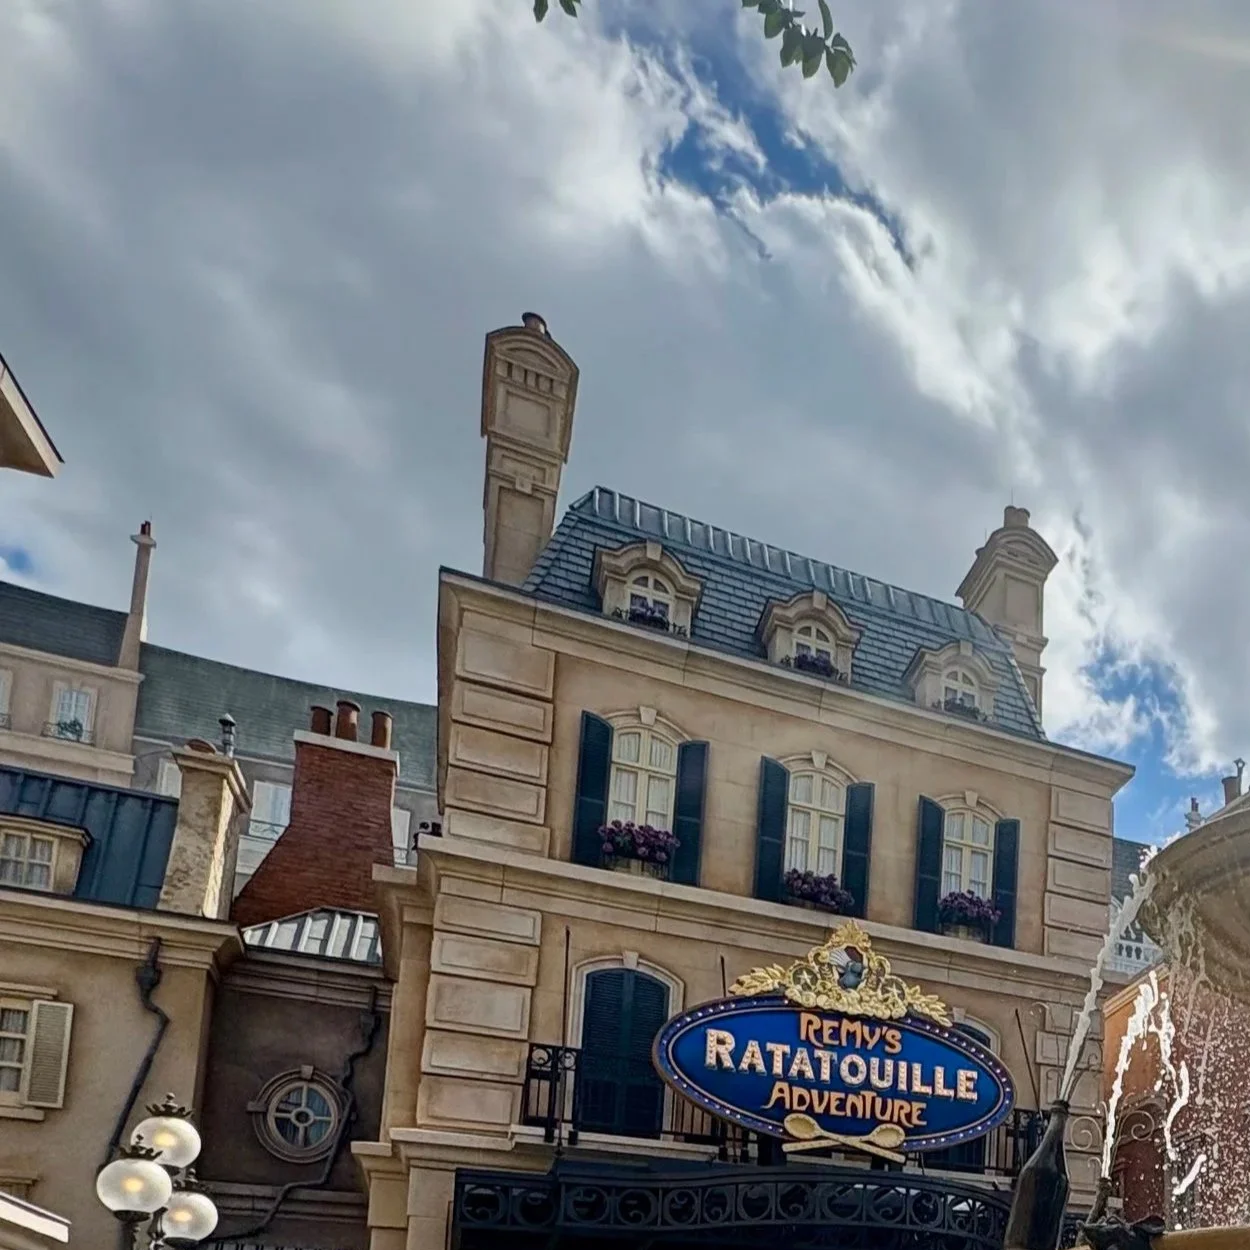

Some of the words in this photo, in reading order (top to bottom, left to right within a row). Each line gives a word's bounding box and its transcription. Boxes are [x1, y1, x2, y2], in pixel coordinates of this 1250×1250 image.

[799, 1011, 902, 1054] REMY'S
[704, 1027, 978, 1104] RATATOUILLE
[761, 1081, 927, 1128] ADVENTURE
